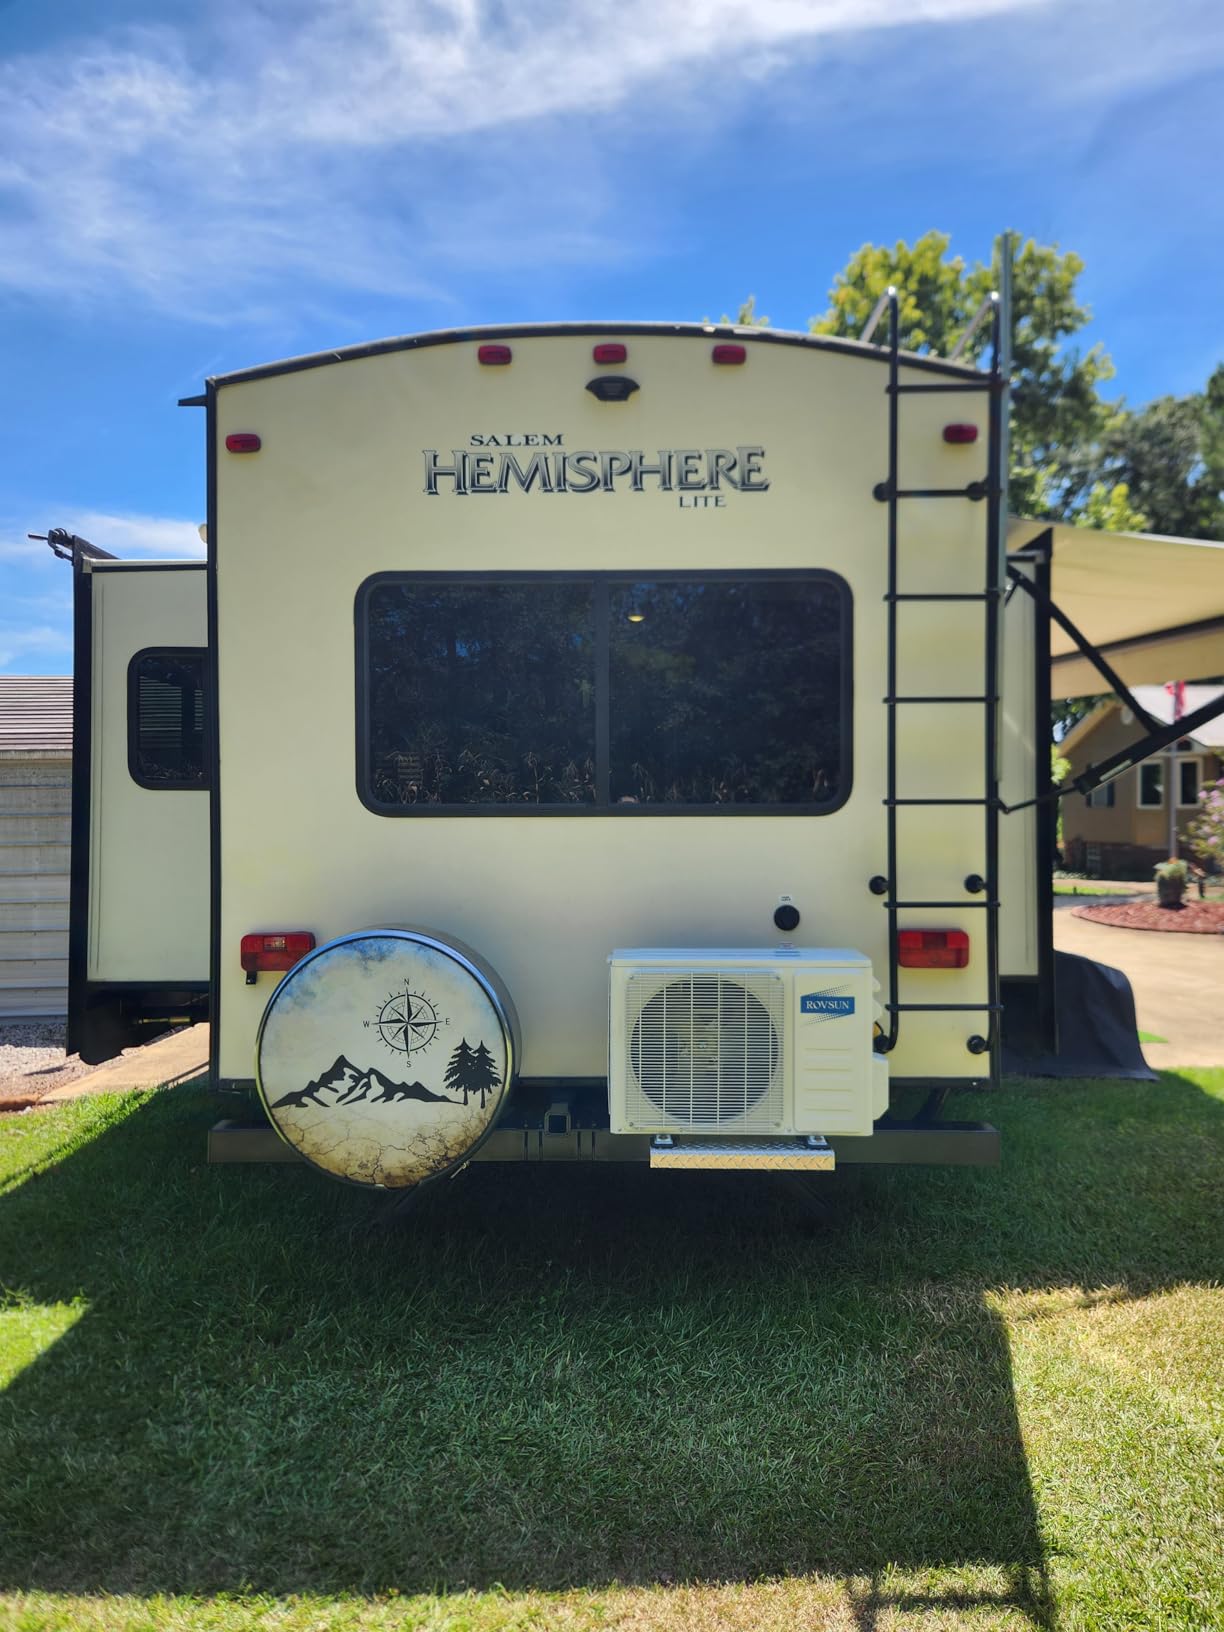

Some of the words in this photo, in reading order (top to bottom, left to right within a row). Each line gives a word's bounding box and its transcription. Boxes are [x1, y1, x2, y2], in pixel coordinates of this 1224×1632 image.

[470, 433, 564, 447] SALEM
[422, 446, 770, 495] HEMISPHERE
[679, 495, 727, 508] LITE
[403, 978, 410, 986] N
[805, 1000, 850, 1010] ROVSUN
[362, 1020, 370, 1028] W
[445, 1017, 451, 1026] E
[406, 1060, 412, 1068] S
